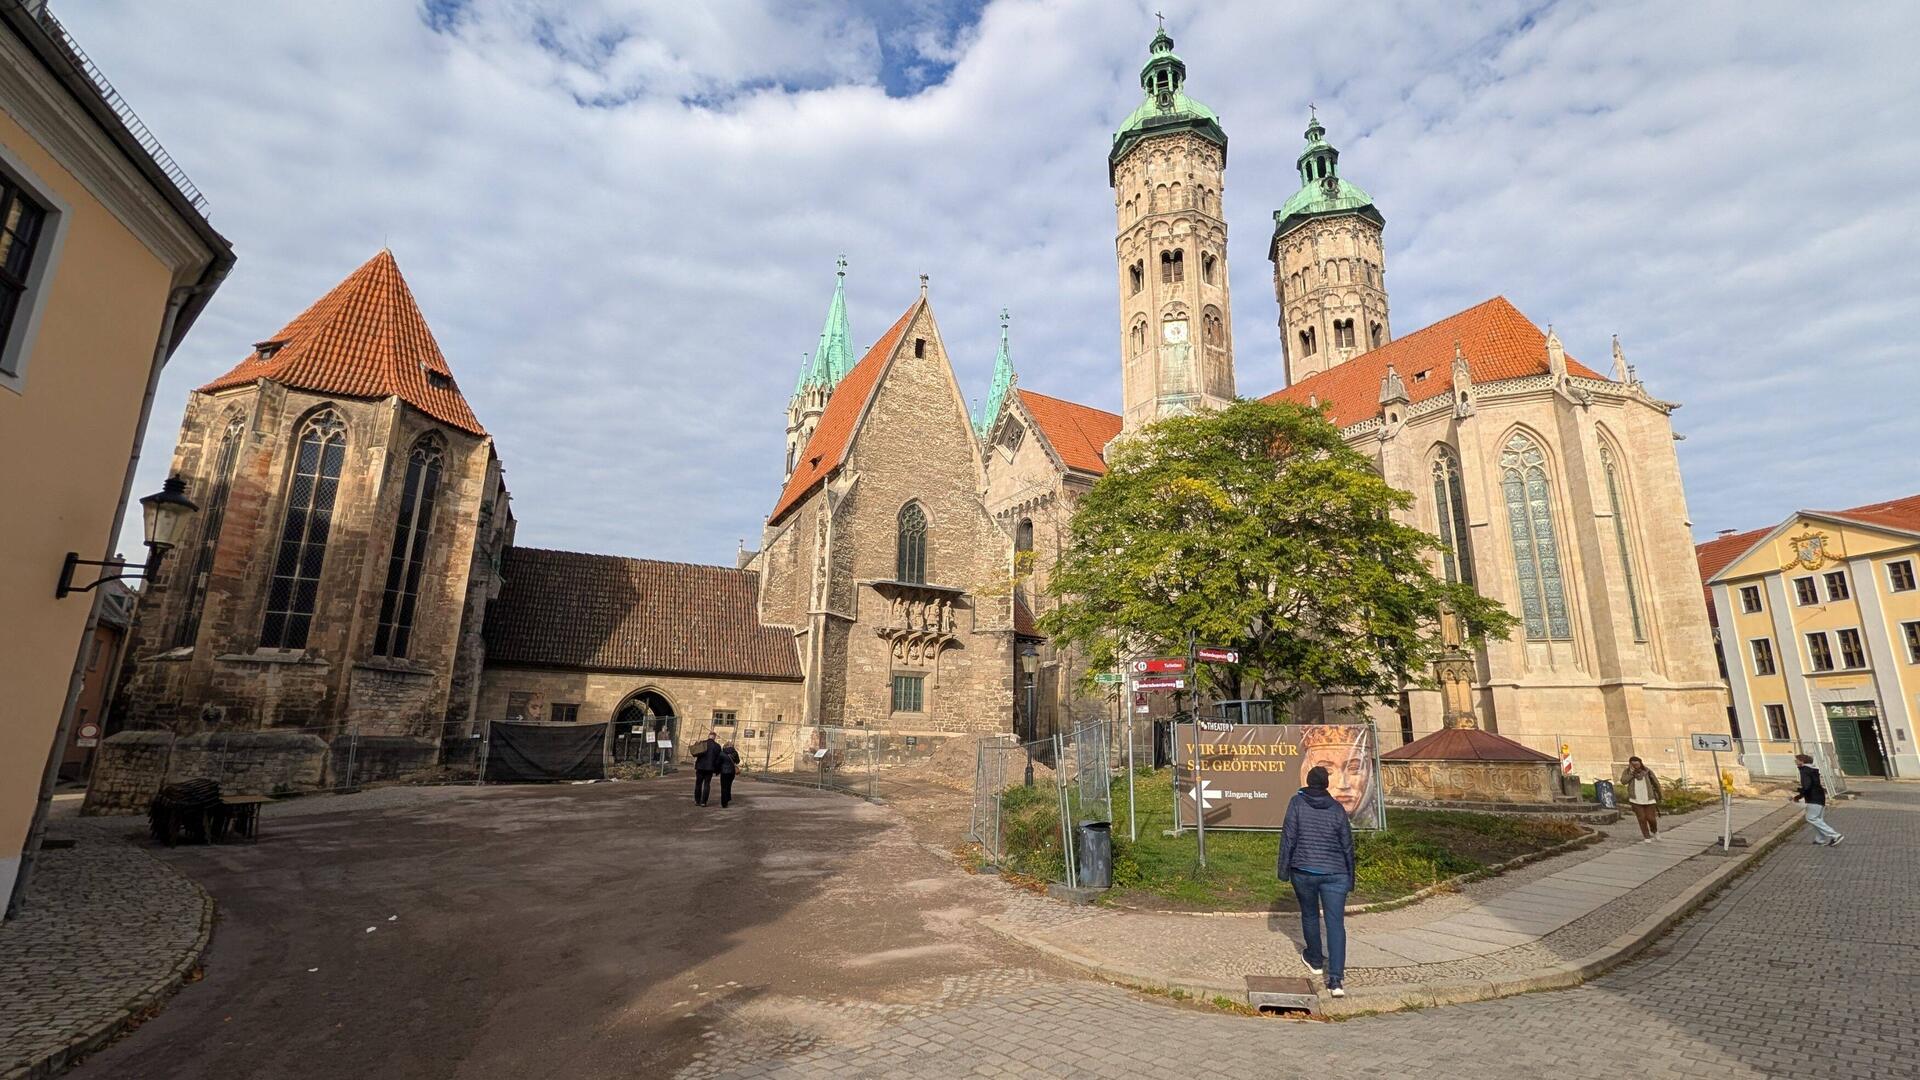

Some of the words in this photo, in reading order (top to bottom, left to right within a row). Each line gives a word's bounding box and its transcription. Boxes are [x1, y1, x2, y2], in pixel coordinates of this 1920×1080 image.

[1207, 722, 1230, 732] THEATER
[1219, 743, 1266, 756] HABEN
[1270, 741, 1298, 756] FÜR
[1187, 759, 1210, 771] SE
[1213, 758, 1286, 772] GEÖFFNET
[1224, 790, 1253, 799] Eingang
[1253, 790, 1268, 798] hier
